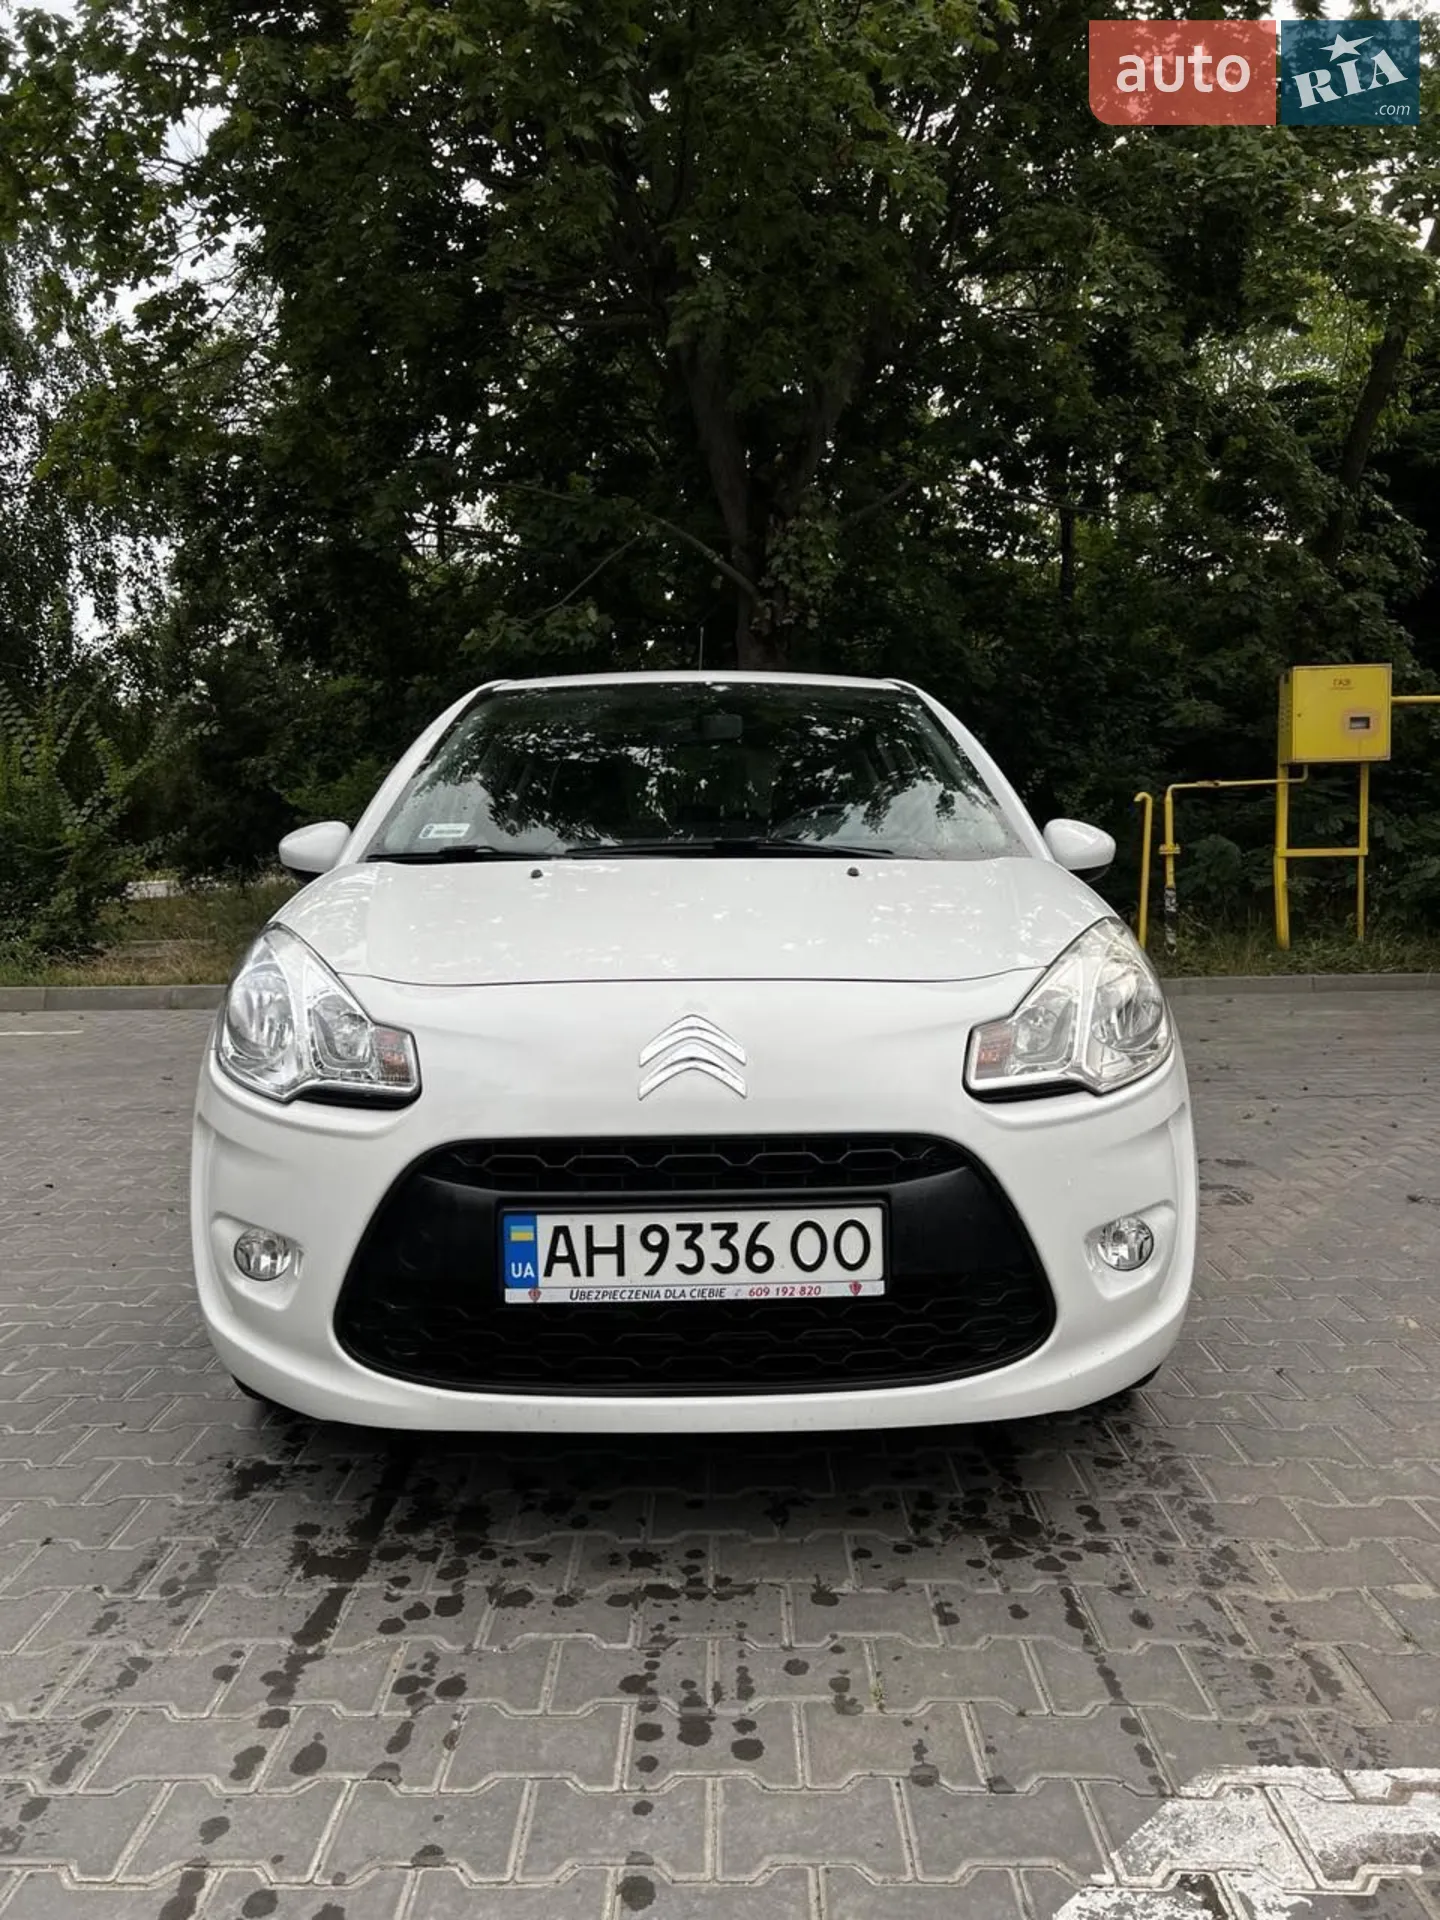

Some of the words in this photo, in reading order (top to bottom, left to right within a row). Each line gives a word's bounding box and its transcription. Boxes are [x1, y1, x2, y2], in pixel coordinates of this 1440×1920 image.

[543, 1223, 626, 1278] AH
[638, 1220, 776, 1277] 9336
[789, 1218, 872, 1273] OO
[510, 1261, 535, 1279] UA
[569, 1287, 661, 1301] UBEZPIECZENIA
[664, 1287, 687, 1300] DLA
[749, 1286, 770, 1297] 609
[775, 1285, 796, 1297] 192
[799, 1285, 822, 1296] 820
